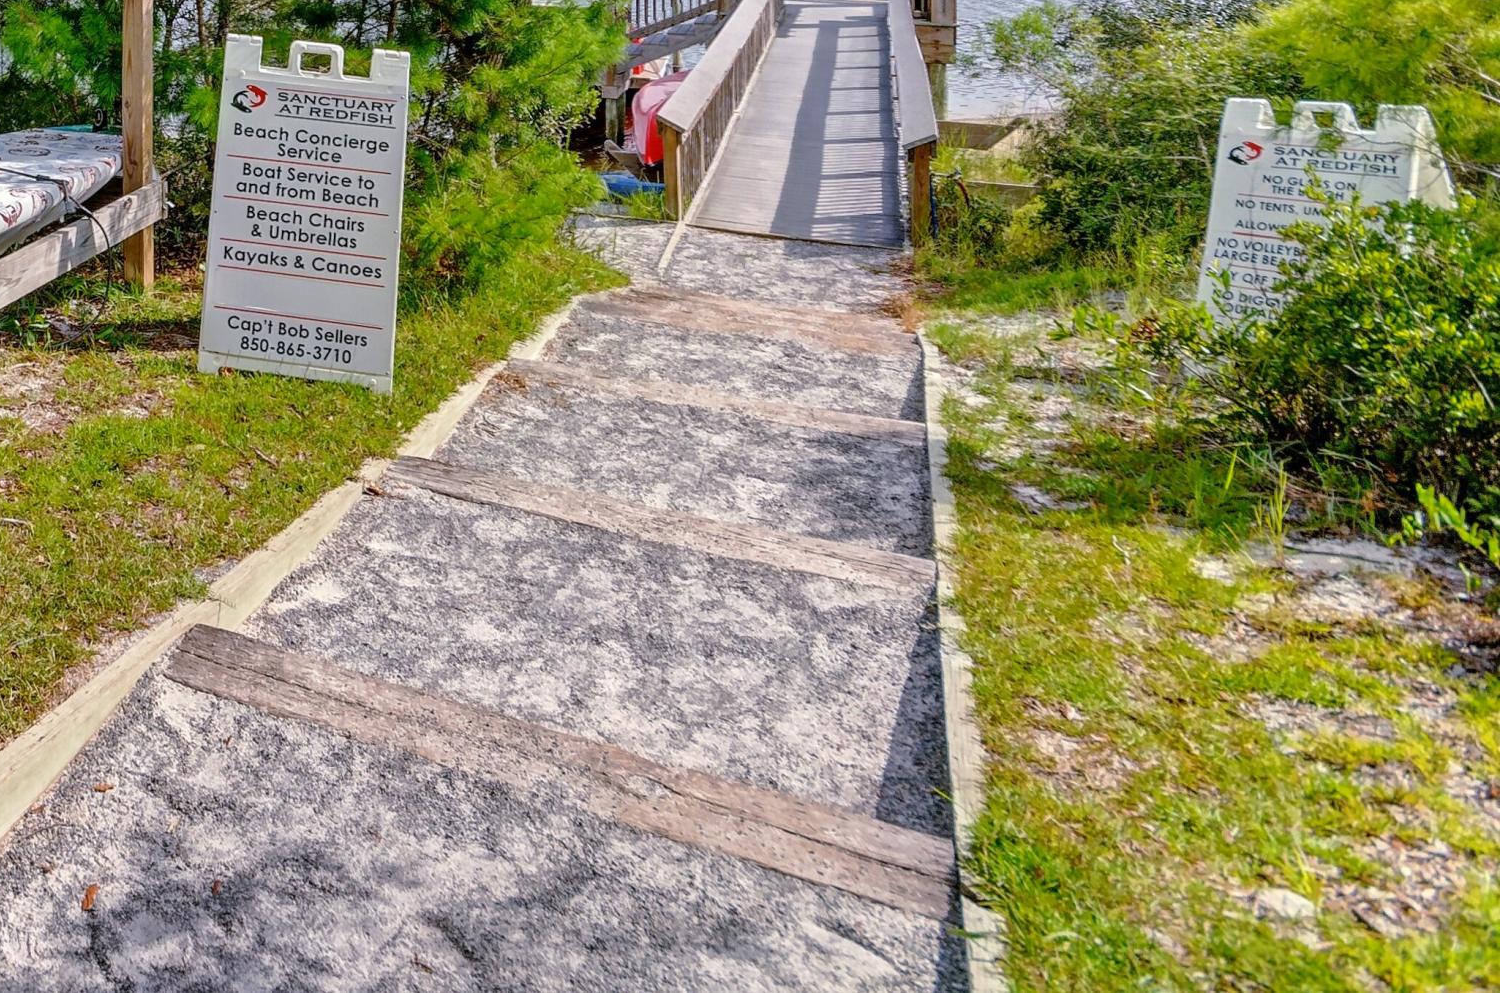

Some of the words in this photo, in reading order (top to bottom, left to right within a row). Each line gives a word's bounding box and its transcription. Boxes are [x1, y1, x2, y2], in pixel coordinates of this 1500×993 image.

[276, 91, 396, 114] SANCTUARY
[279, 104, 304, 115] AT
[309, 108, 393, 126] REDFISH
[233, 122, 289, 141] Beach
[295, 129, 390, 154] Concierge
[277, 143, 342, 163] Service
[1274, 147, 1399, 164] SANCUARY
[243, 162, 282, 180] Boat
[287, 167, 352, 188] Service
[358, 175, 375, 190] to
[1276, 157, 1300, 167] AT
[1306, 159, 1397, 175] REDFISH
[1263, 175, 1283, 184] NO
[1334, 181, 1357, 191] ON
[1272, 186, 1294, 196] THE
[236, 181, 271, 195] and
[276, 183, 315, 201] from
[322, 188, 379, 208] Beach
[1235, 199, 1255, 209] NO
[246, 205, 303, 225] Beach
[309, 213, 365, 232] Chairs
[251, 223, 262, 238] &
[269, 225, 357, 249] Umbrellas
[1217, 237, 1239, 248] NO
[223, 245, 288, 266] Kayaks
[294, 255, 305, 270] &
[312, 257, 382, 279] Canoes
[1214, 249, 1258, 264] LARGE
[227, 315, 273, 335] Cap't
[278, 322, 309, 339] Bob
[315, 326, 368, 347] Sellers
[240, 336, 352, 364] 850-865-3710
